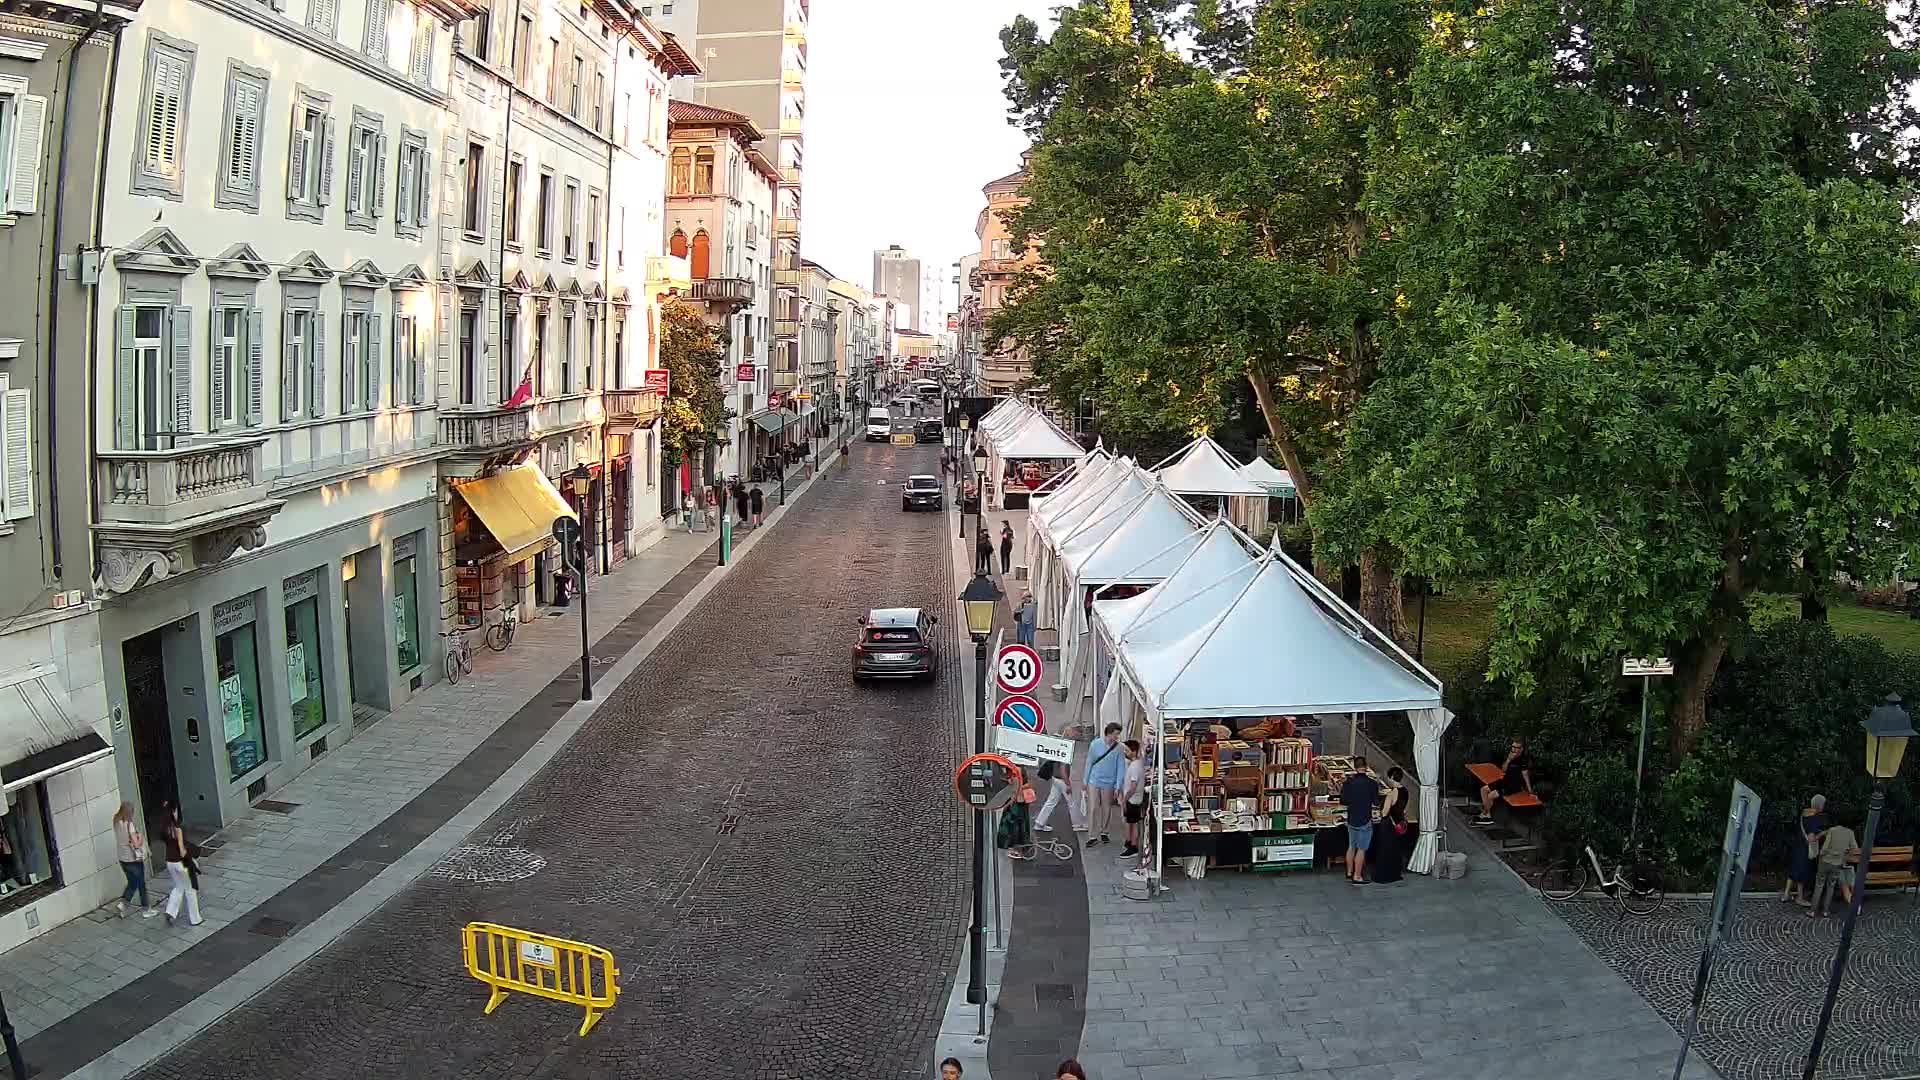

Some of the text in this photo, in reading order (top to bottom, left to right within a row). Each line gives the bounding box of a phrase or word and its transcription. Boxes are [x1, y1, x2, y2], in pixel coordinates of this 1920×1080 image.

[1004, 658, 1032, 680] 30
[221, 678, 240, 700] 130
[1036, 744, 1067, 758] Dante
